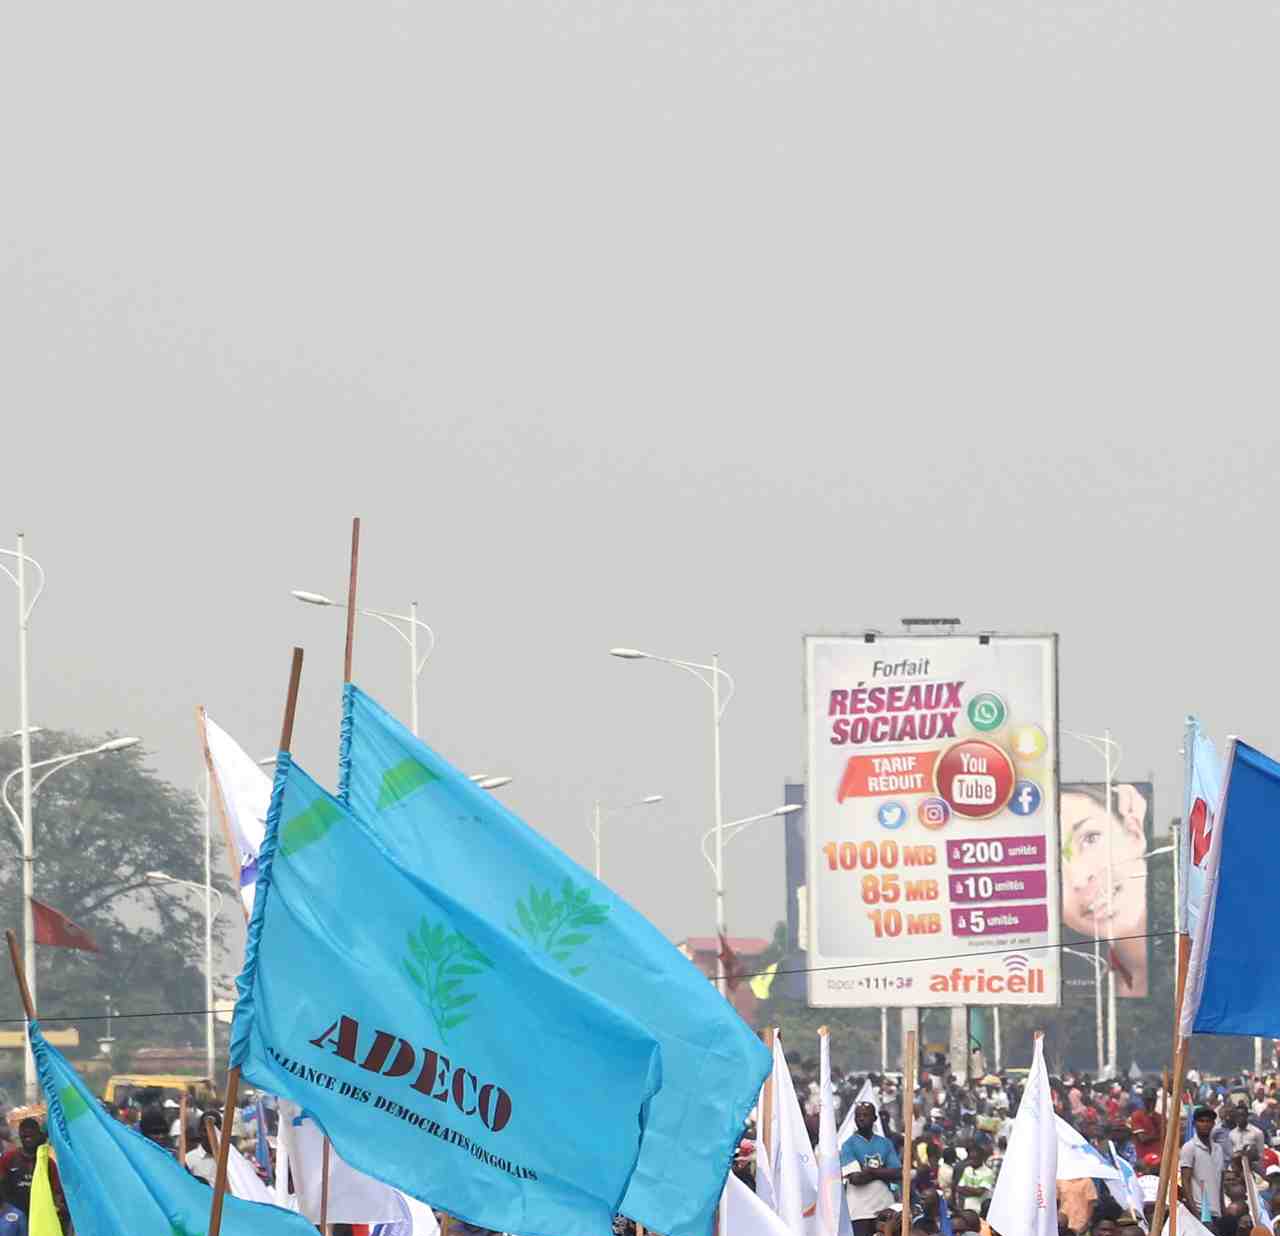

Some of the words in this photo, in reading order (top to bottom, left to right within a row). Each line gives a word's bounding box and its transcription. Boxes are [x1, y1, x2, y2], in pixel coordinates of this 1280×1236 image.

[873, 658, 930, 679] Forfait
[828, 681, 966, 716] RÉSEAUX
[830, 712, 960, 745] SOCIAUX
[872, 757, 917, 774] TARIF
[960, 753, 988, 775] You
[956, 779, 993, 800] Tube
[823, 841, 898, 871] 1000
[903, 846, 936, 866] MB
[962, 841, 1003, 863] 200
[861, 875, 900, 904] 85
[905, 880, 939, 901] MB
[965, 877, 992, 899] 10
[868, 911, 901, 937] 10
[907, 914, 941, 935] MB
[970, 911, 985, 933] 5
[929, 967, 1044, 993] africell
[309, 1015, 512, 1133] ADECO
[340, 1081, 372, 1104] DES
[374, 1095, 471, 1150] DEMOCRATES
